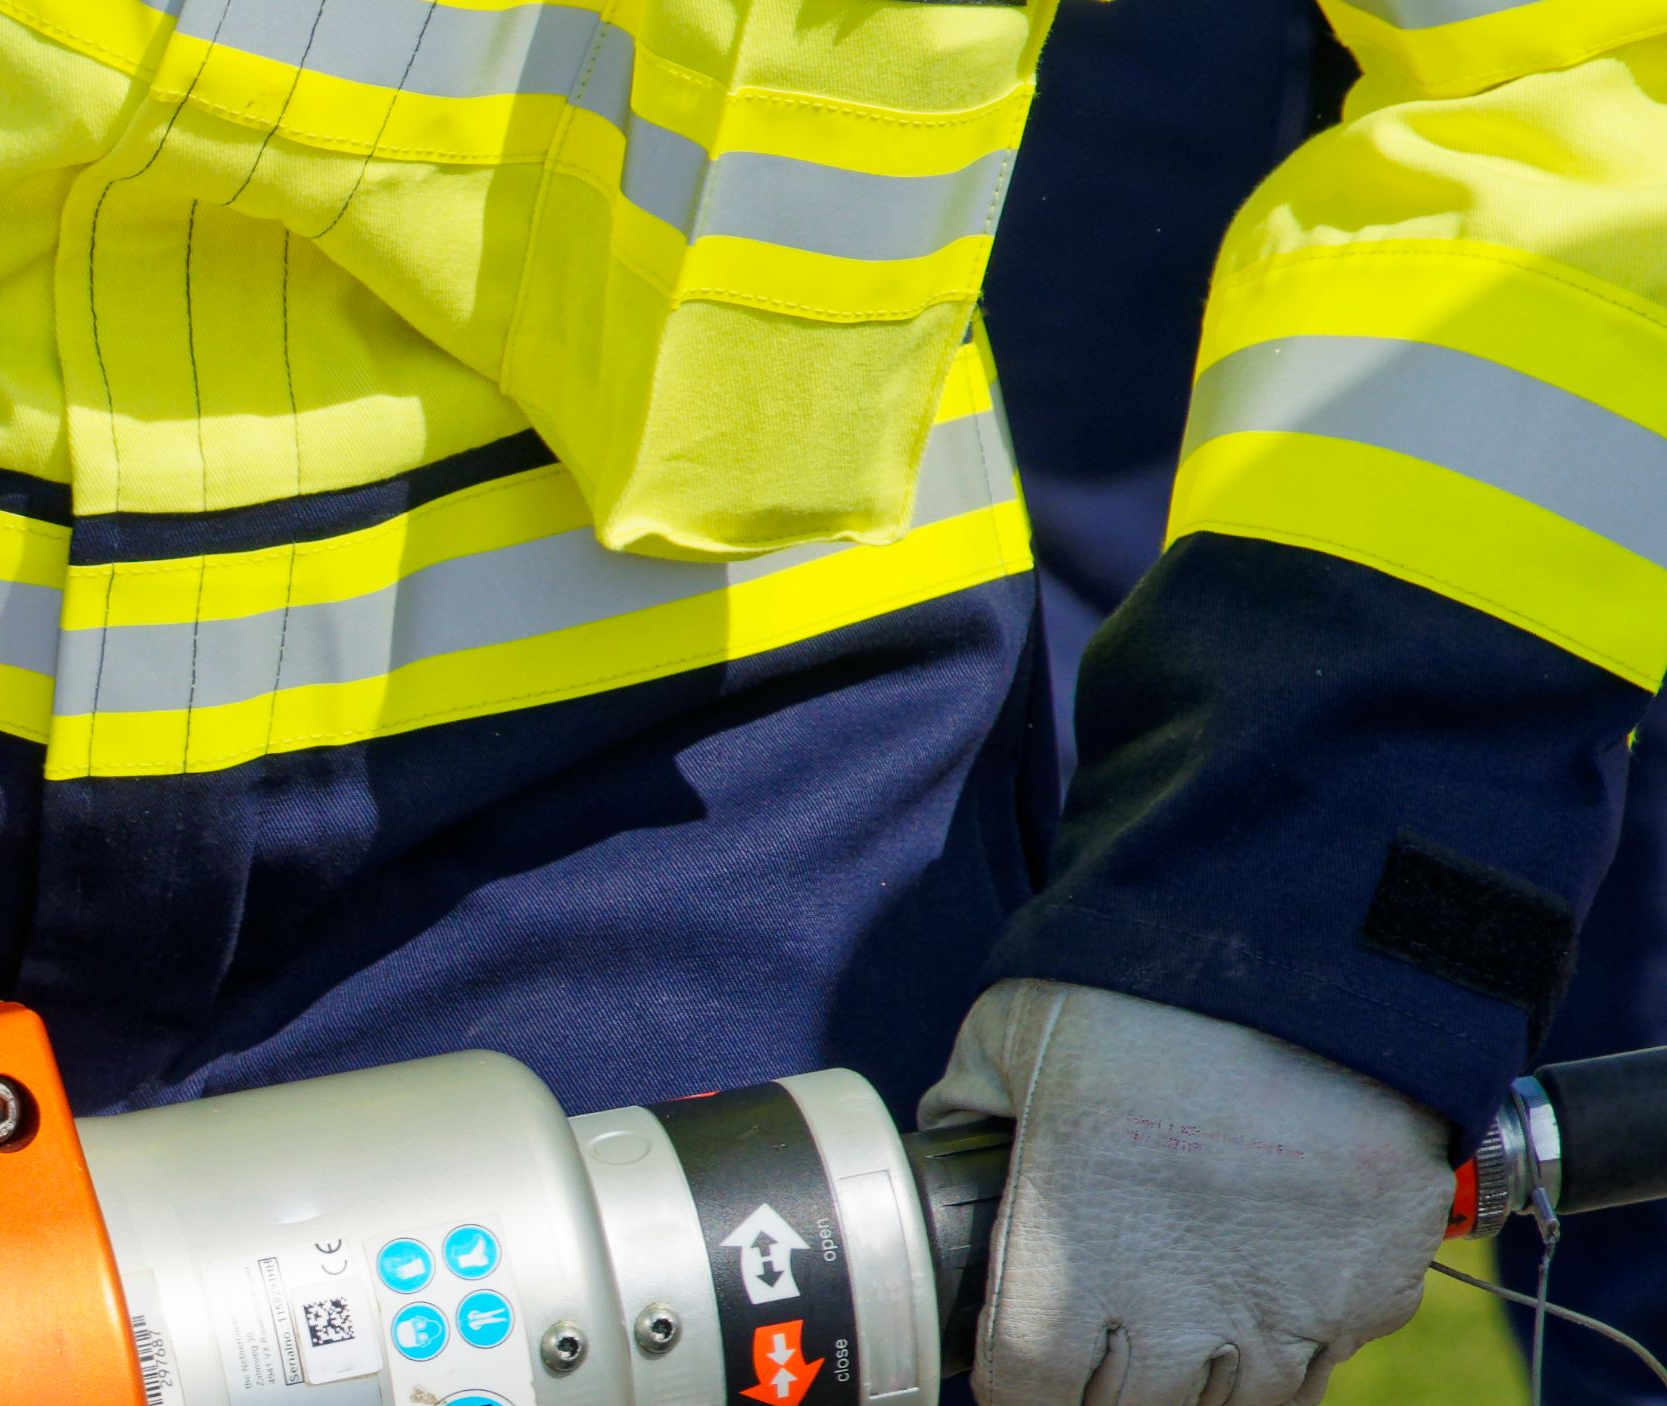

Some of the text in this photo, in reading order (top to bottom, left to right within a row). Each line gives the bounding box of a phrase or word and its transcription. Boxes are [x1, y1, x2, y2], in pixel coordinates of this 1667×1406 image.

[817, 1218, 839, 1263] open
[148, 1330, 173, 1388] 297687
[834, 1338, 850, 1382] close
